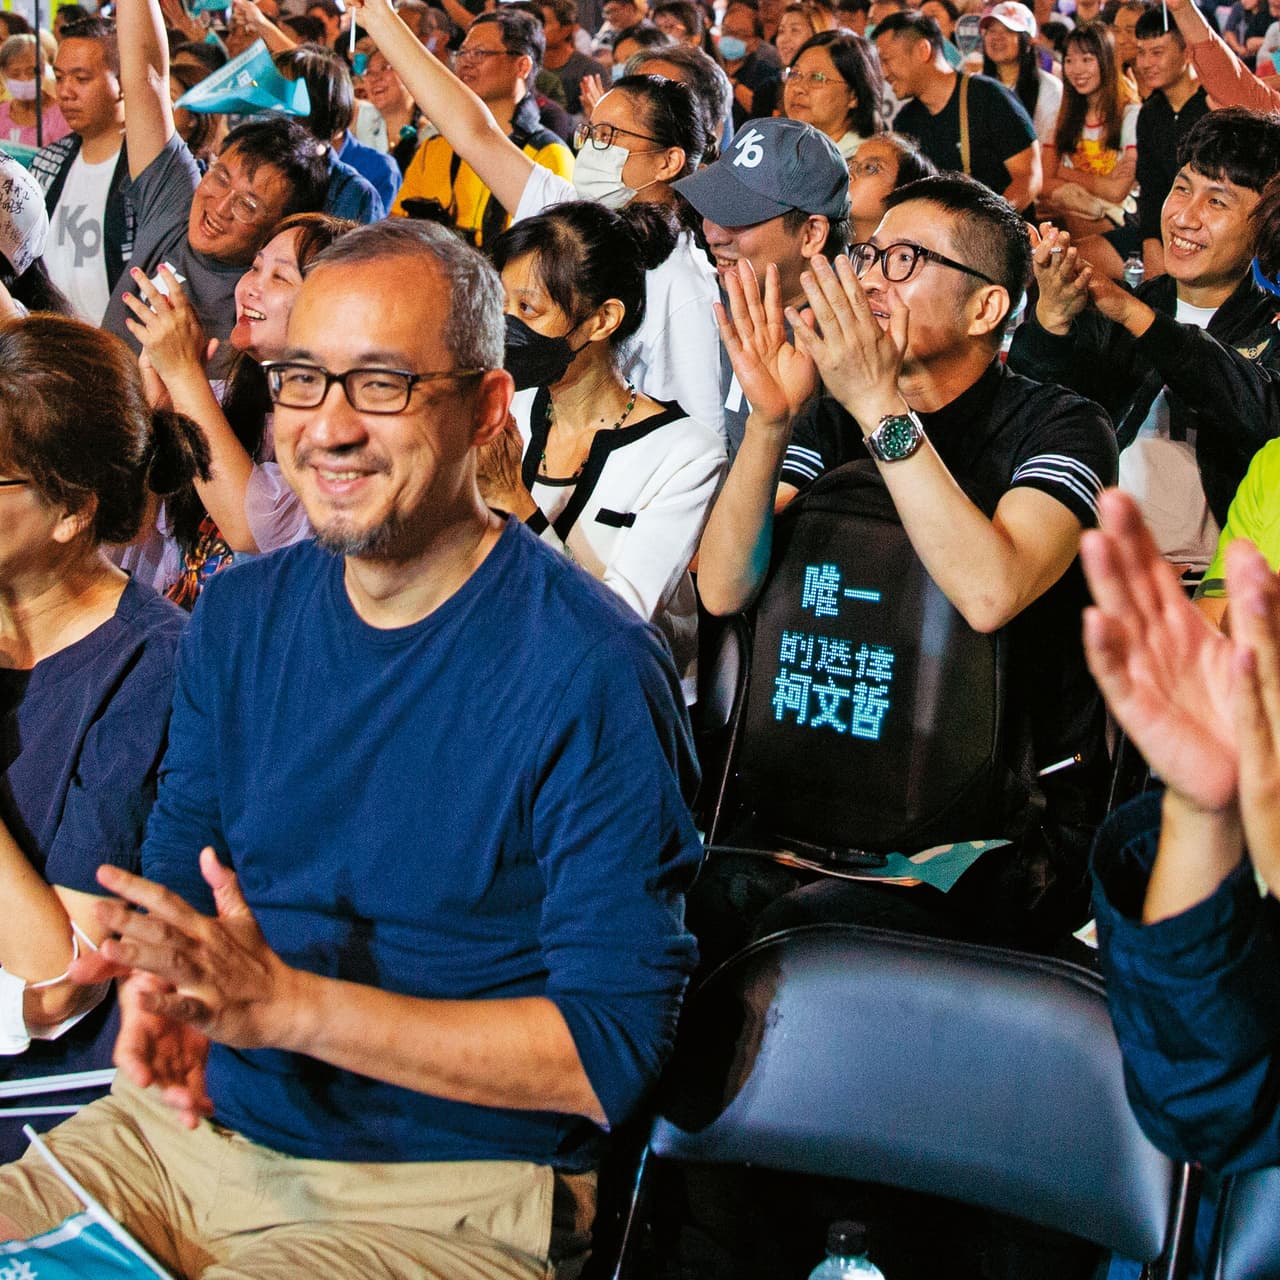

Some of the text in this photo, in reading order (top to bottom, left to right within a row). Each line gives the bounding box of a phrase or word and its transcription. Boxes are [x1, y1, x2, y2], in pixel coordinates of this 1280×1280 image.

[801, 564, 882, 617] 唯一
[772, 667, 890, 740] 柯文哲
